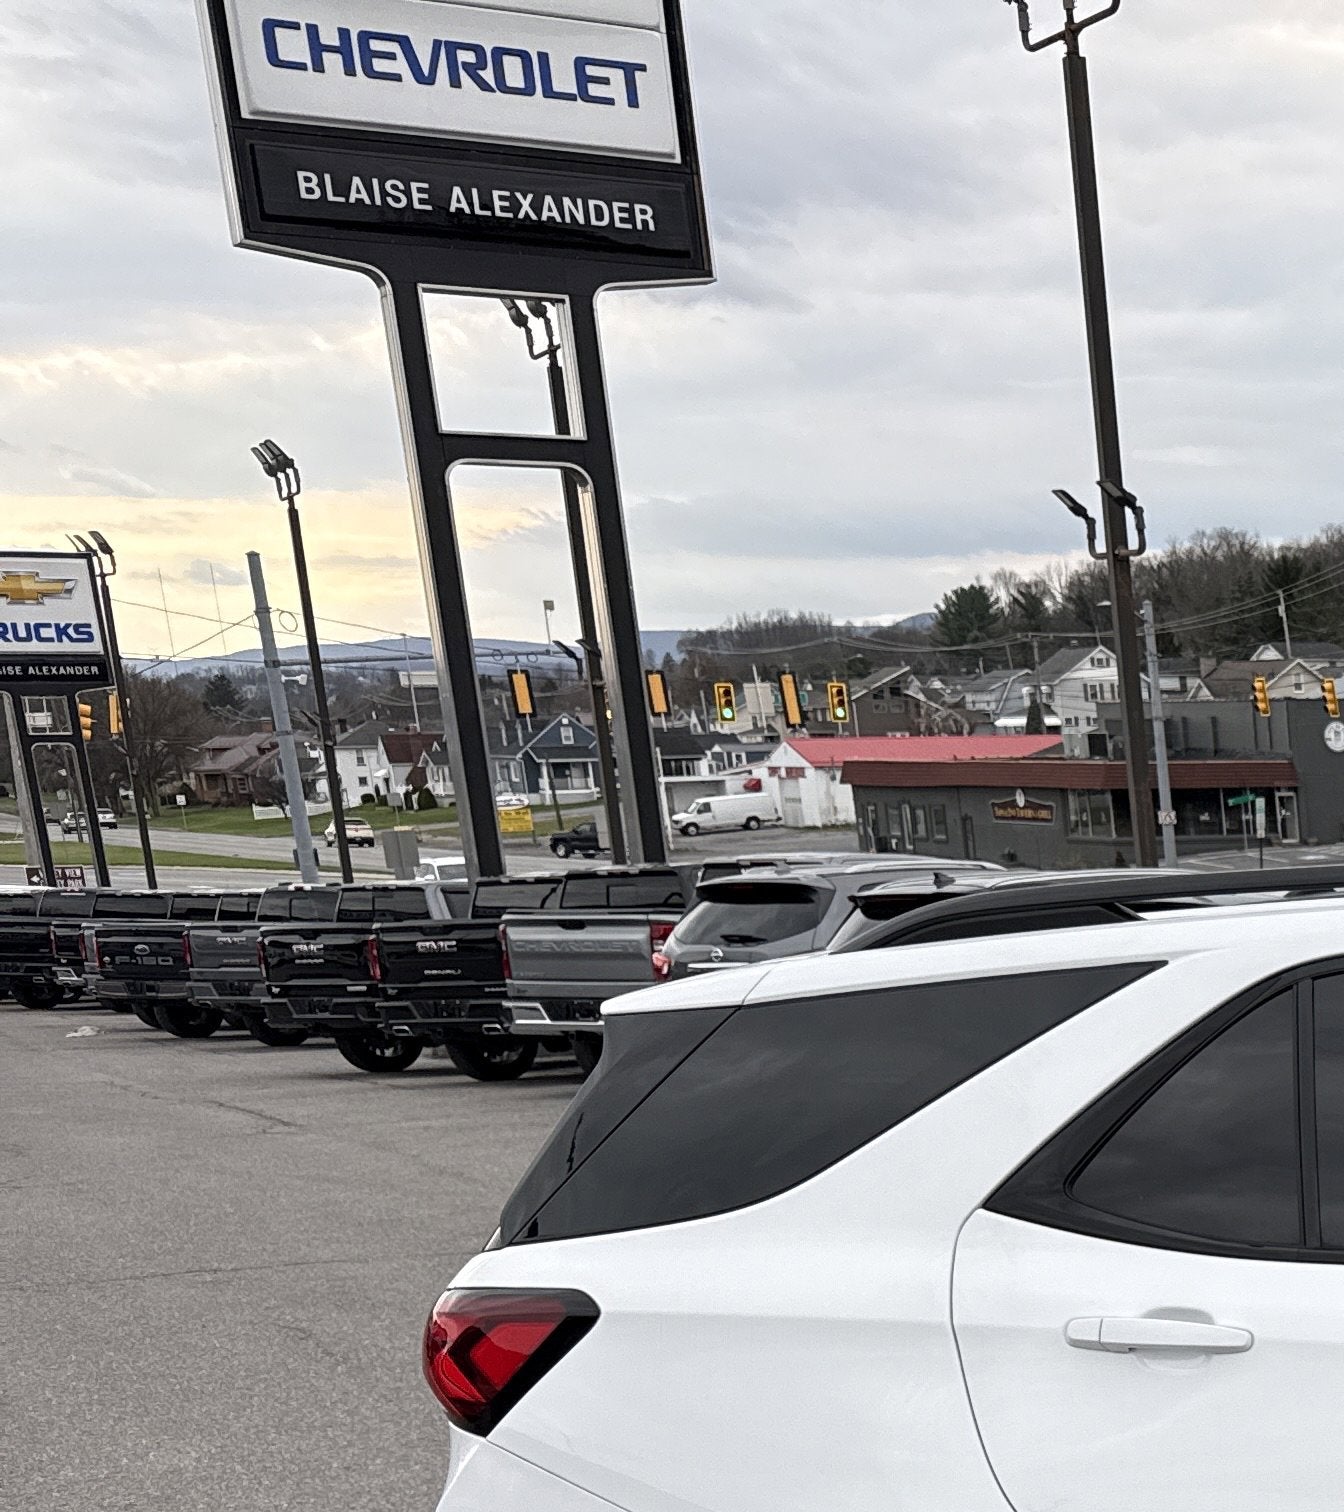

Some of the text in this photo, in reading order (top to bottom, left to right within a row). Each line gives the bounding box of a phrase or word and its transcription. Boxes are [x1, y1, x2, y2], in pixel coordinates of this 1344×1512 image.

[262, 17, 647, 108] CHEVROLET
[296, 170, 656, 232] BLAISE ALEXANDER
[28, 666, 99, 675] ALEXANDER
[416, 940, 457, 953] GMC
[511, 940, 641, 953] CHEVROLET
[115, 955, 174, 966] F-150
